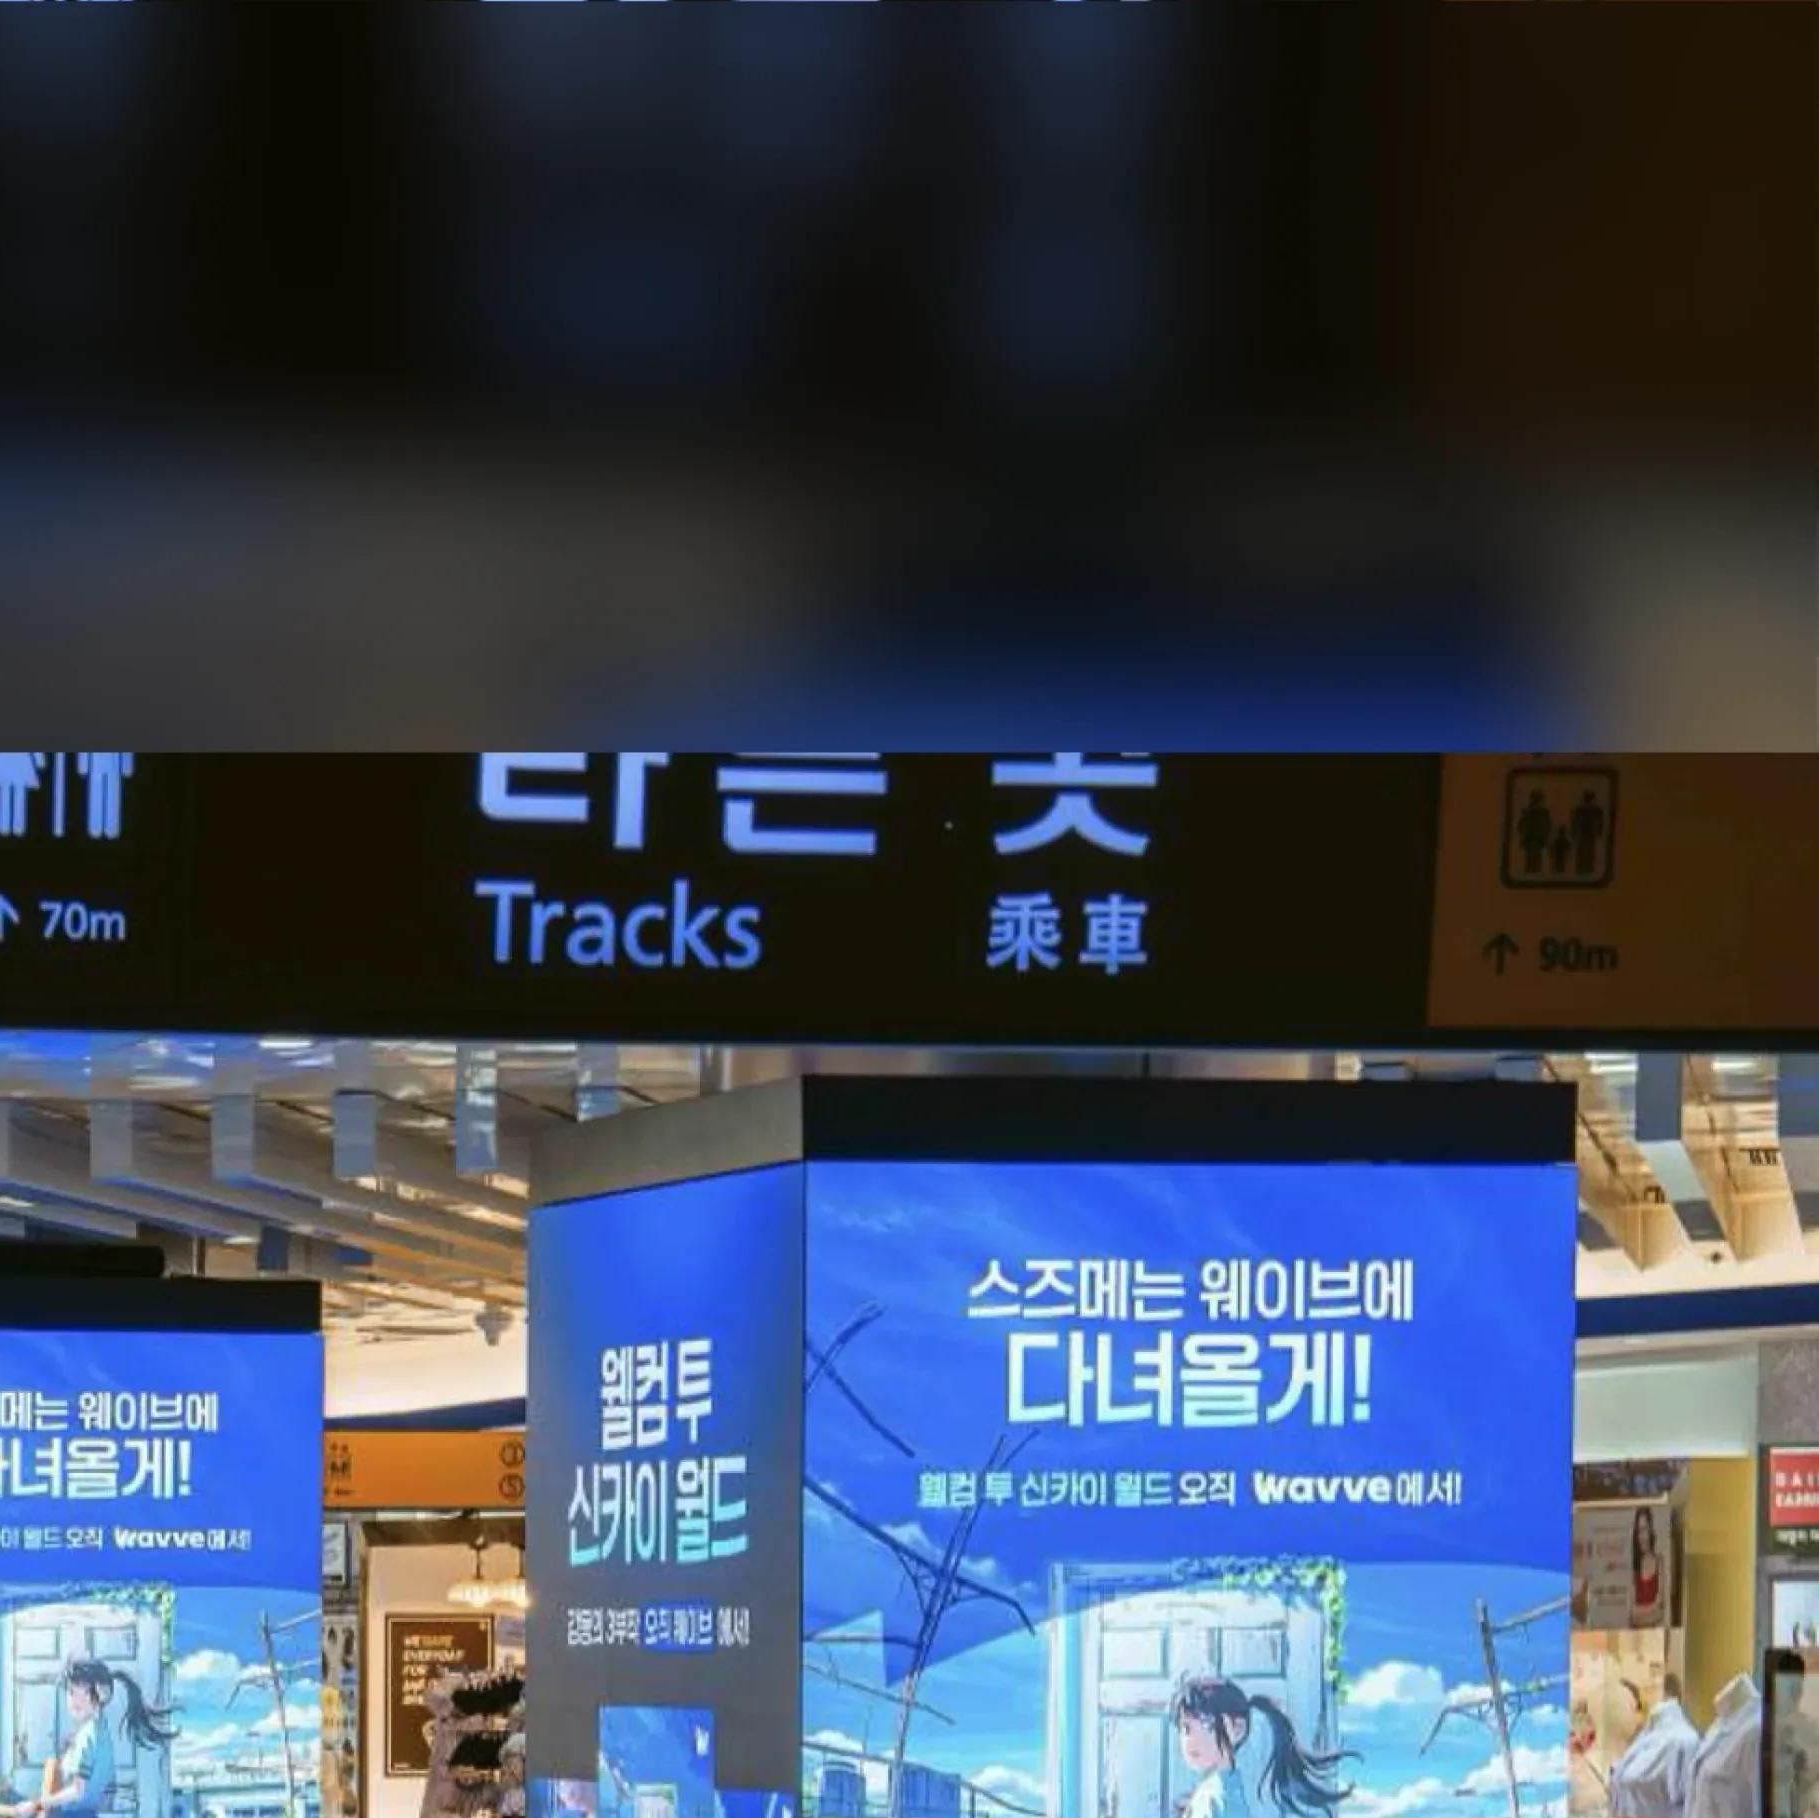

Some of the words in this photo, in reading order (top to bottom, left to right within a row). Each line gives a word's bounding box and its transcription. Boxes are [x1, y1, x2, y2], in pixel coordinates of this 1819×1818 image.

[40, 902, 127, 941] 70m
[475, 878, 762, 969] Tracks
[1538, 936, 1619, 973] 90m
[967, 1258, 1186, 1321] 스즈메는
[1199, 1257, 1415, 1322] 웨이브에
[675, 1338, 713, 1445] 투
[1006, 1329, 1373, 1428] 다녀올게!
[77, 1390, 219, 1433] 웨이브에
[568, 1459, 667, 1567] 신카이
[675, 1456, 749, 1565] 월드
[1020, 1472, 1108, 1506] 신카이
[1178, 1472, 1235, 1506] 오직
